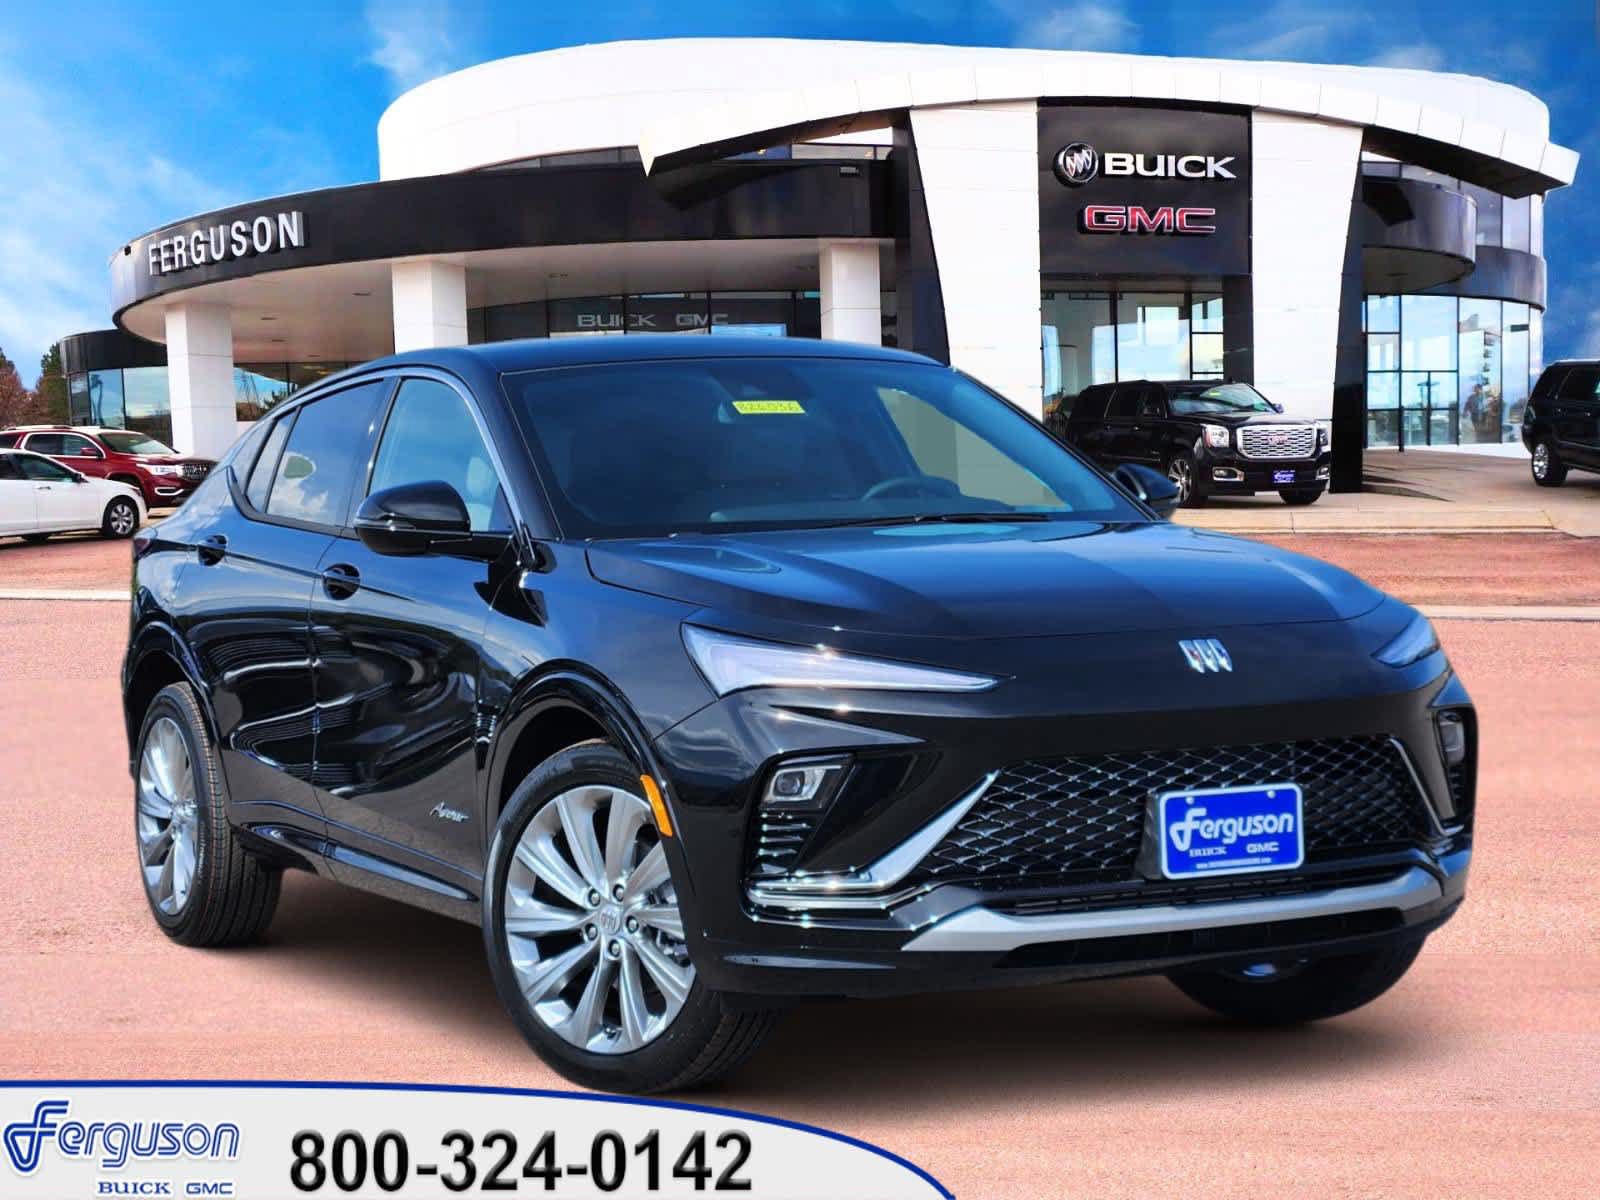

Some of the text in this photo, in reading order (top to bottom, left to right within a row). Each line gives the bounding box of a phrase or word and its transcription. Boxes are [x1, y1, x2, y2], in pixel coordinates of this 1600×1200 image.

[1105, 153, 1236, 178] BUICK
[1085, 205, 1216, 233] GMC
[149, 211, 303, 275] FERGUSON
[577, 314, 728, 327] BUICK GMC
[1169, 808, 1294, 851] Ferguson
[1247, 842, 1279, 853] GMC
